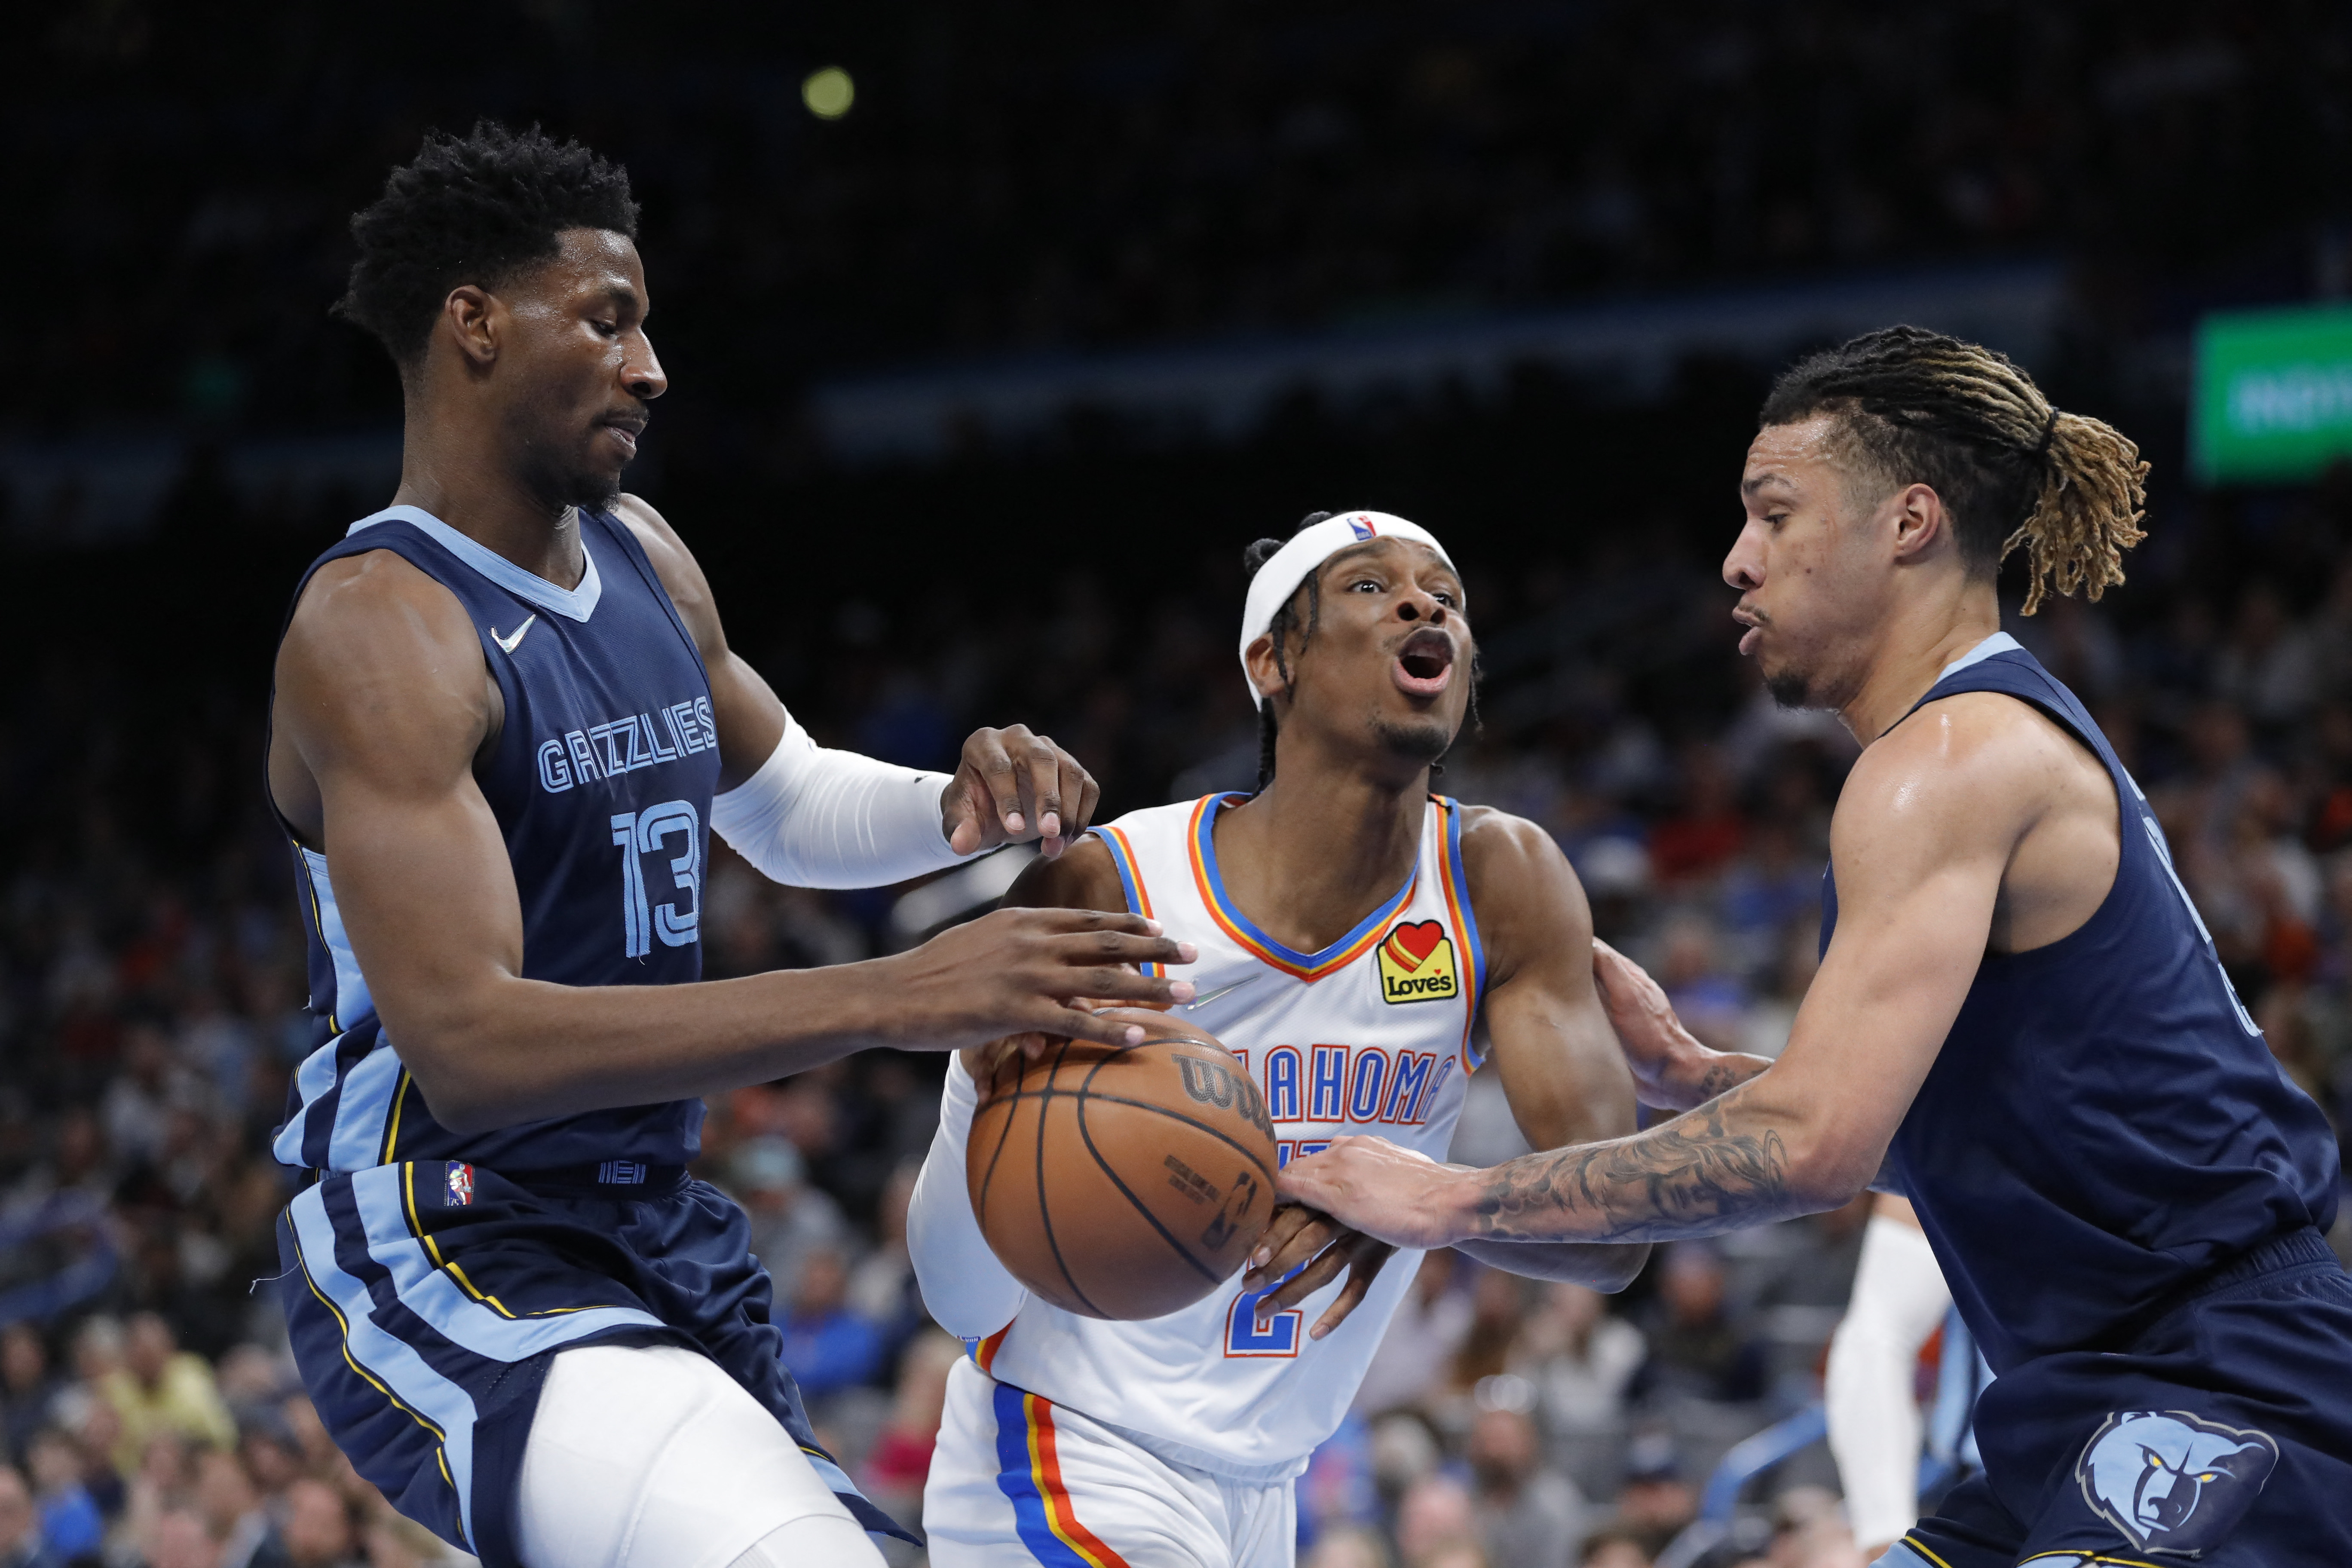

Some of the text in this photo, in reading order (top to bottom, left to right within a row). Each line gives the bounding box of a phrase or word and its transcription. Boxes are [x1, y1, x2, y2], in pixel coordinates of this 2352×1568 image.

[537, 695, 717, 793] GRIZZLIES
[610, 799, 701, 958] 13
[1231, 1044, 1456, 1125] AHOMA
